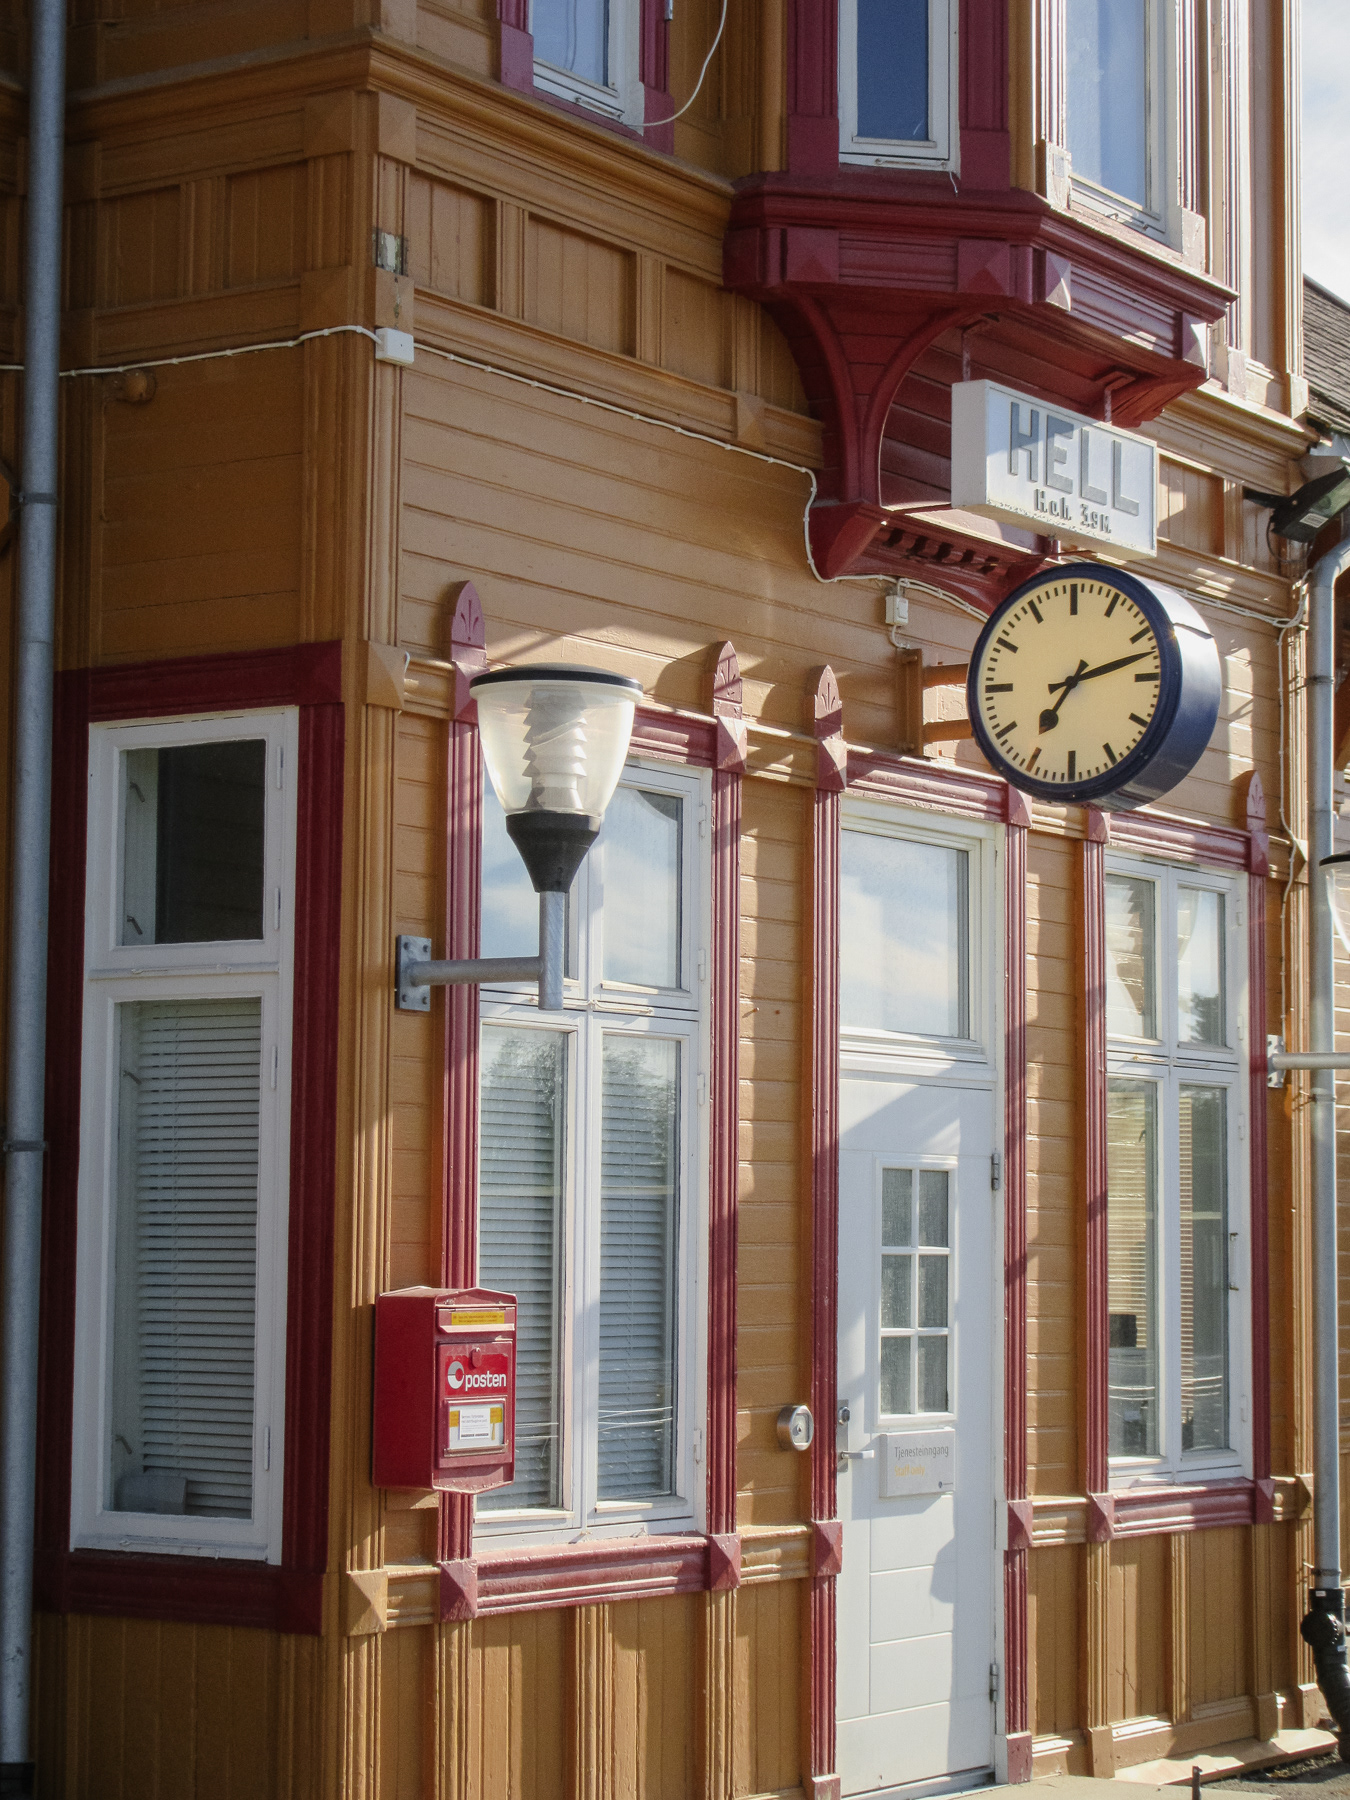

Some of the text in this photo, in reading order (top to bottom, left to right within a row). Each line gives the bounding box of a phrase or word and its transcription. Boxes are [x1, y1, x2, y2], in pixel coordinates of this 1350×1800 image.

[1009, 402, 1140, 516] HELL
[465, 1370, 507, 1391] posten
[894, 1446, 949, 1460] Tjenesteinngang
